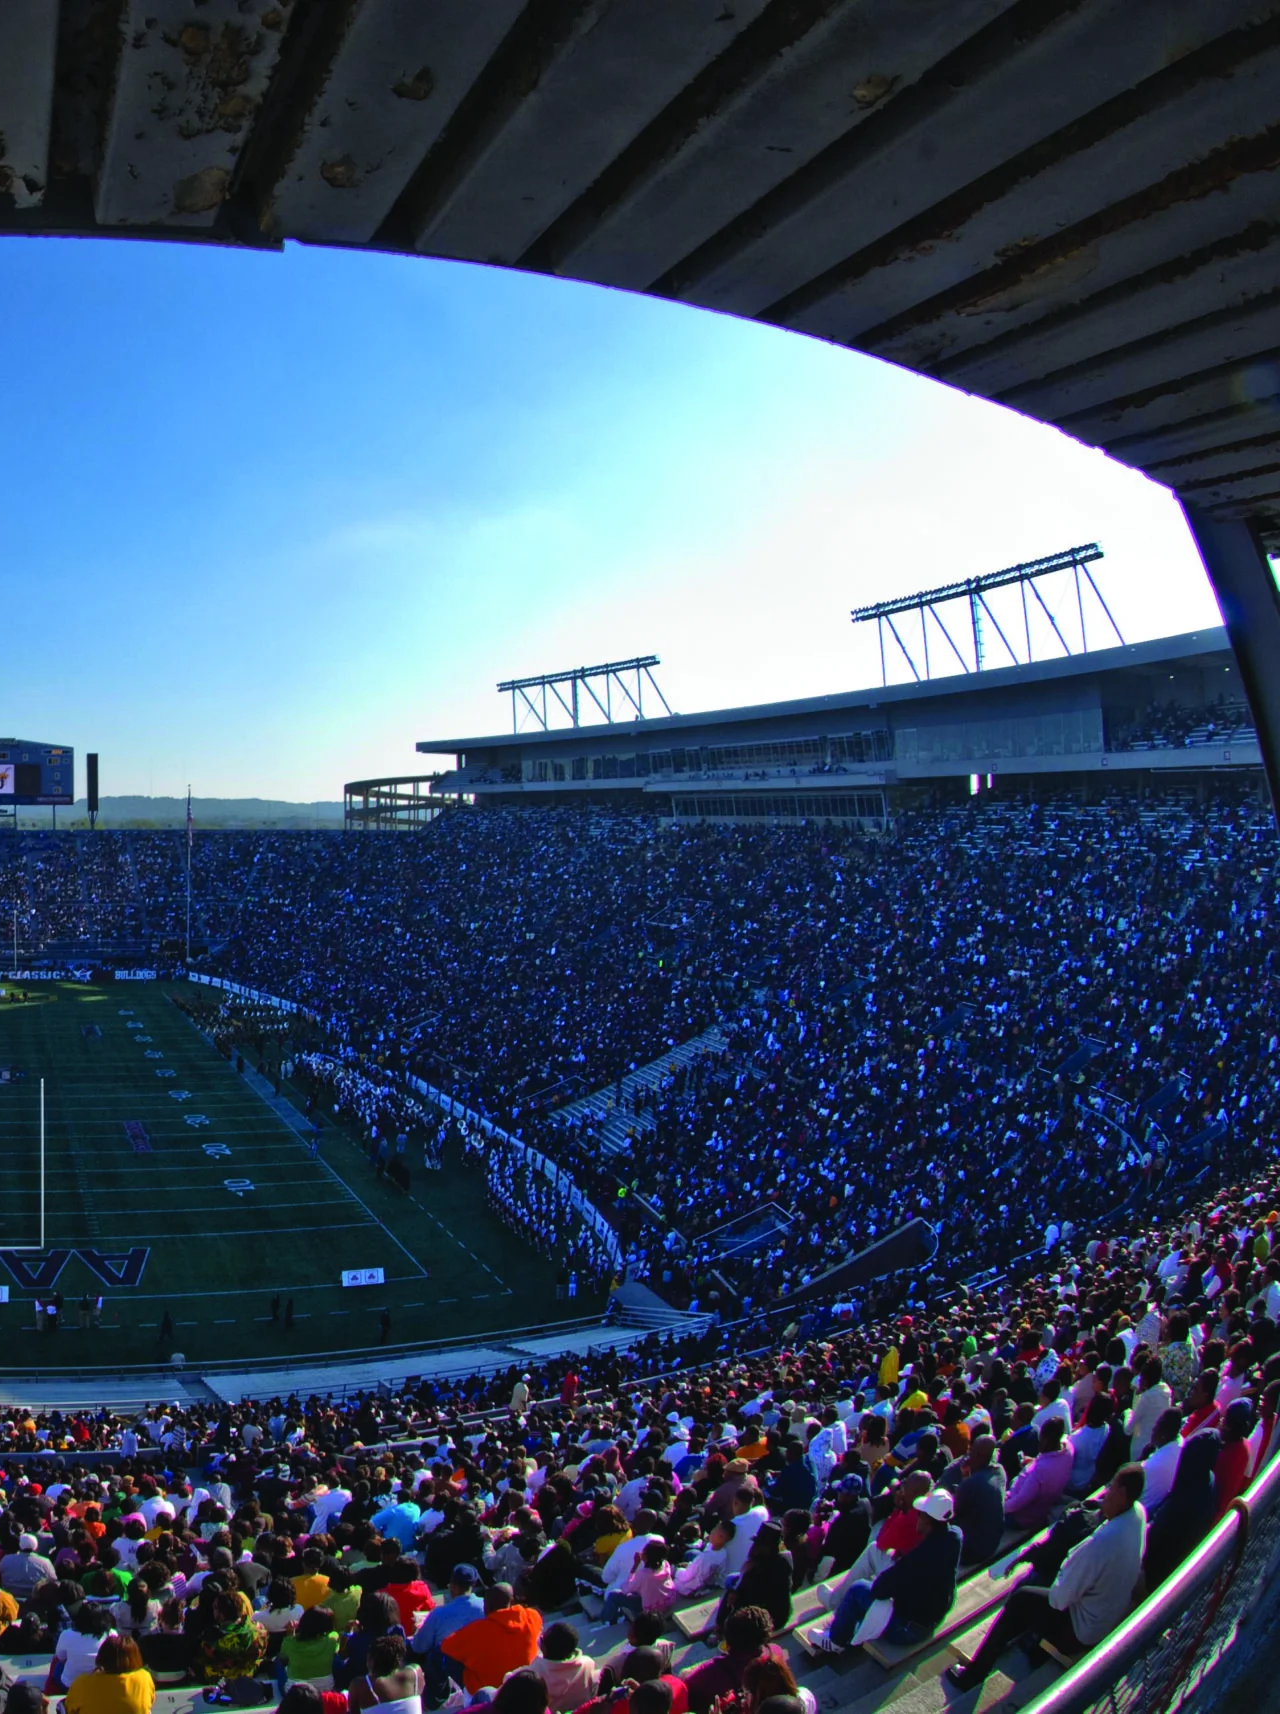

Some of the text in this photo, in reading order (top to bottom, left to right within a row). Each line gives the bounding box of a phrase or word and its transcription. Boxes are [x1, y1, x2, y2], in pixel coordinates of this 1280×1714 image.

[8, 969, 61, 980] CLASSIC
[114, 970, 157, 980] BULLDOGS
[223, 1178, 256, 1192] 10
